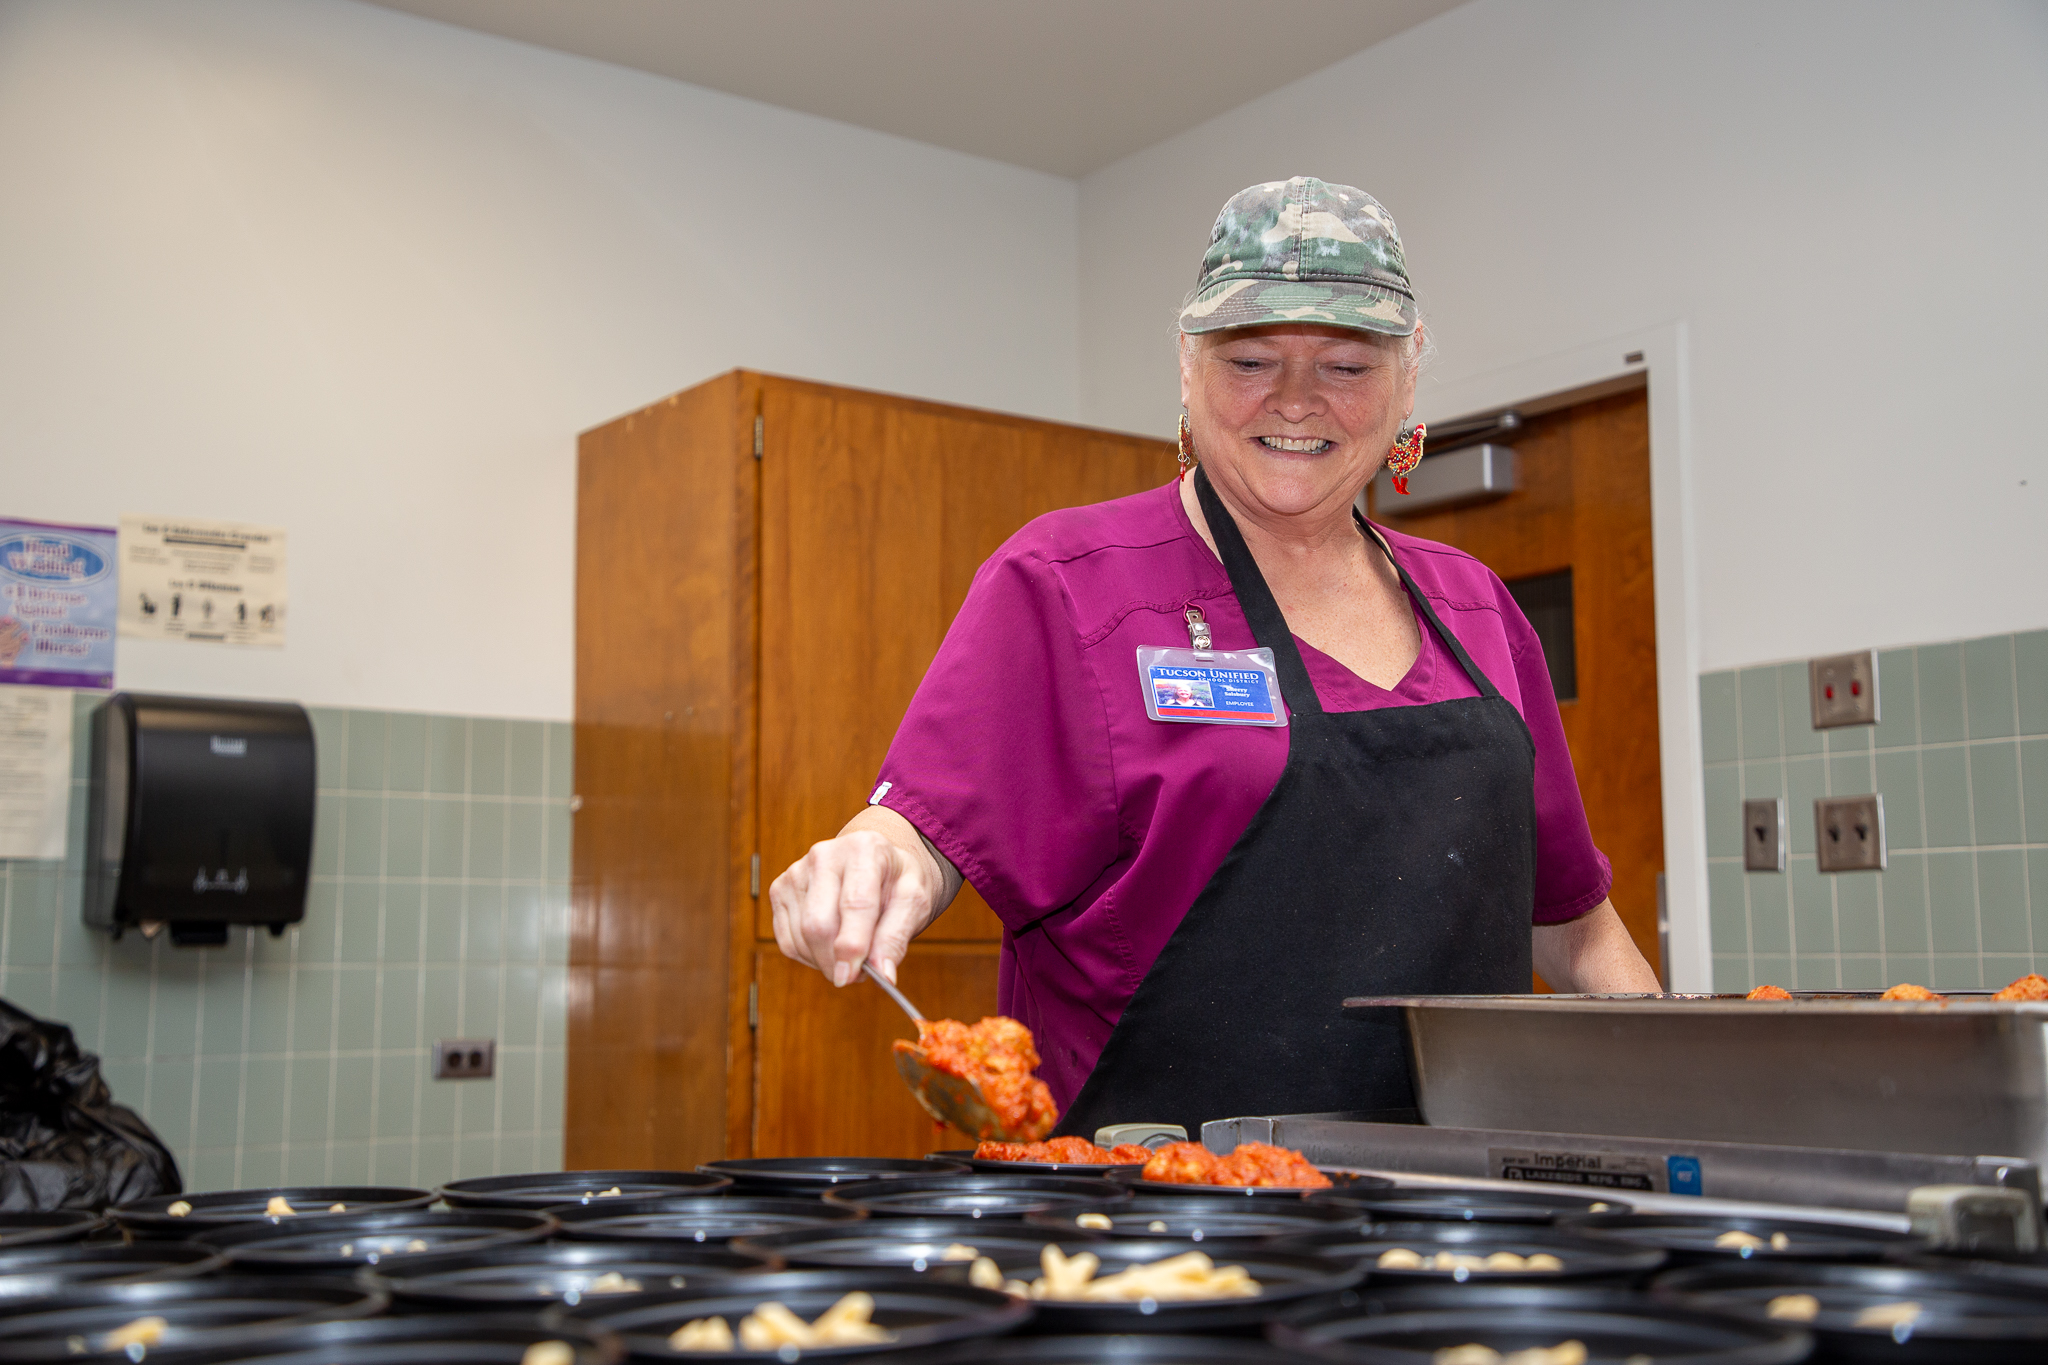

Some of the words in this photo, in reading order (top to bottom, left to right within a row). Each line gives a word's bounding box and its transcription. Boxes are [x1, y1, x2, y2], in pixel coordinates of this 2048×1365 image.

[1157, 667, 1206, 678] TUCSON
[1210, 670, 1259, 680] UNIFIED
[1534, 1152, 1601, 1169] Imperial
